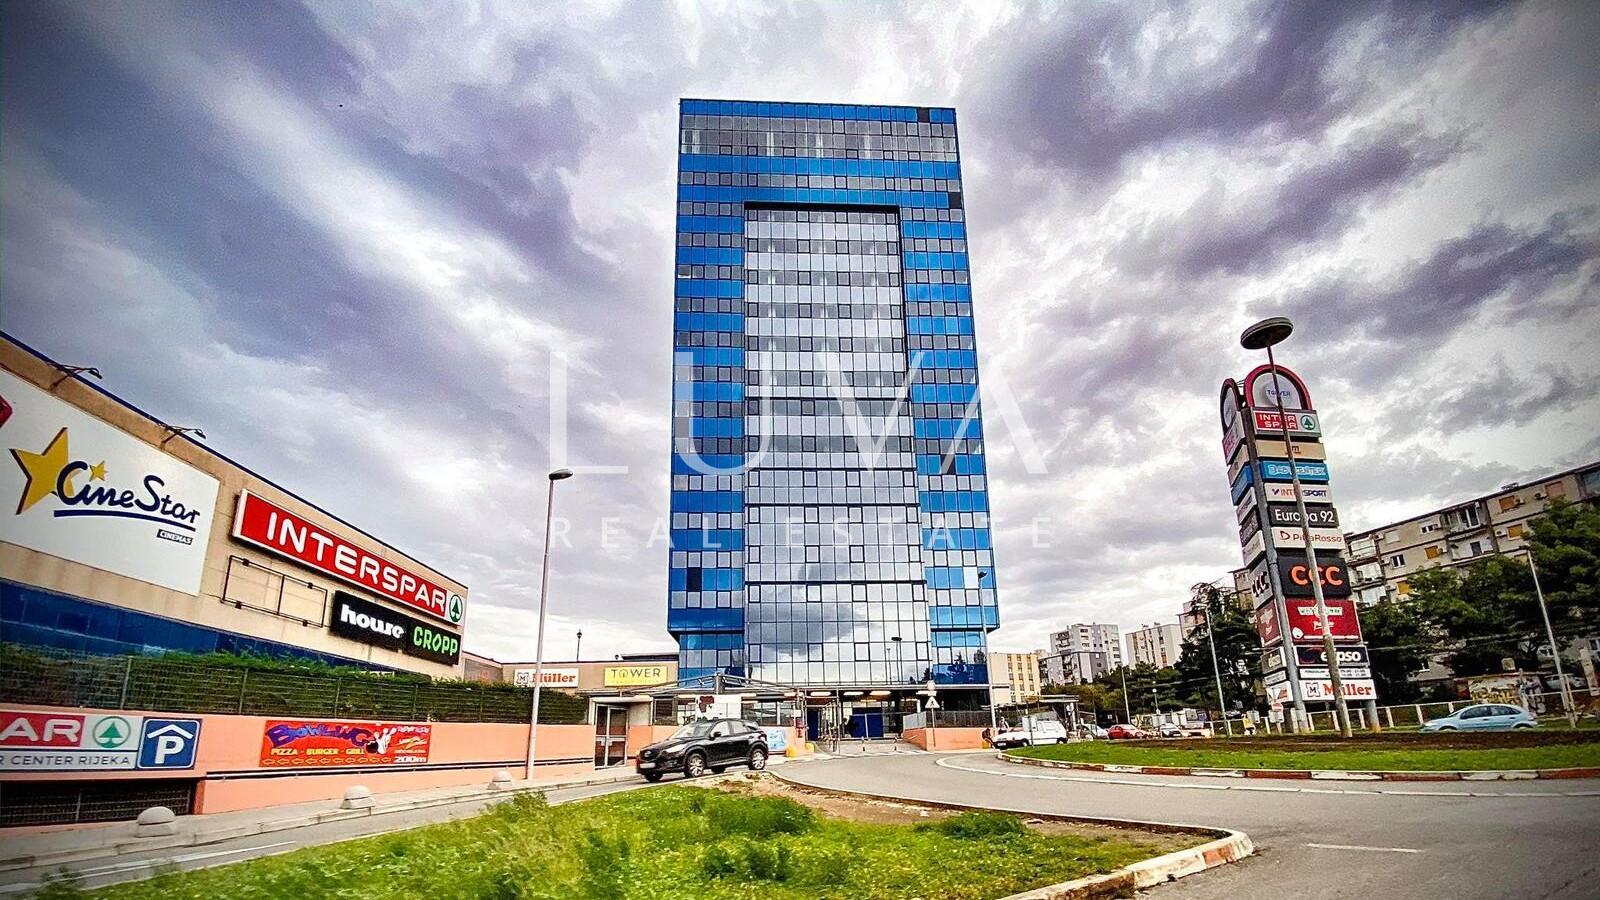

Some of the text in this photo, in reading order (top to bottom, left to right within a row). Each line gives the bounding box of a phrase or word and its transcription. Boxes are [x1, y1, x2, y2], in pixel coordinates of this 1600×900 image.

[56, 461, 201, 524] CineStar
[1320, 511, 1335, 523] 92
[159, 530, 192, 545] CINEMAS
[266, 511, 445, 615] INTERSPAR
[413, 626, 459, 657] CROPP
[610, 667, 661, 678] TOWER
[271, 748, 298, 756] PIZZA
[11, 755, 74, 766] CENTER
[78, 755, 131, 765] RIJEKA
